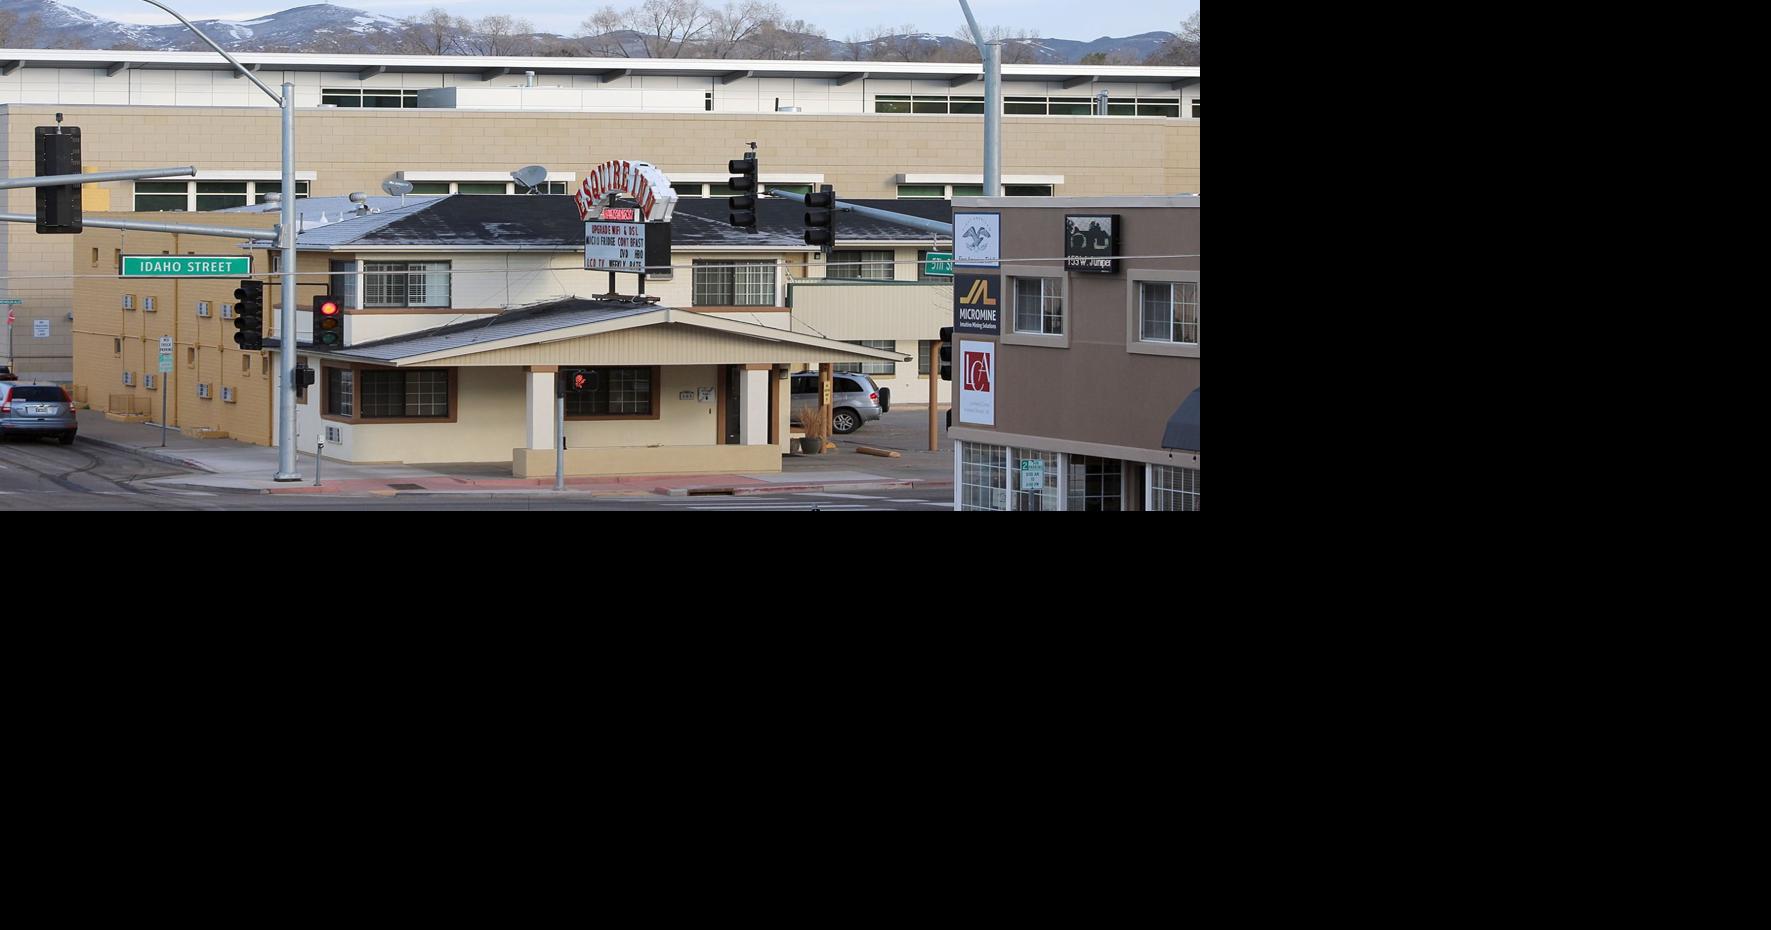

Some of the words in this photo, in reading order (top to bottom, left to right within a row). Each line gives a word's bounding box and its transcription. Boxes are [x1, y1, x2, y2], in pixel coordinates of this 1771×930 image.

[575, 160, 630, 220] ESQUIRE
[631, 168, 656, 220] INN
[140, 261, 181, 272] IDAHO
[187, 261, 233, 272] STREET
[960, 308, 996, 321] MICROMINE
